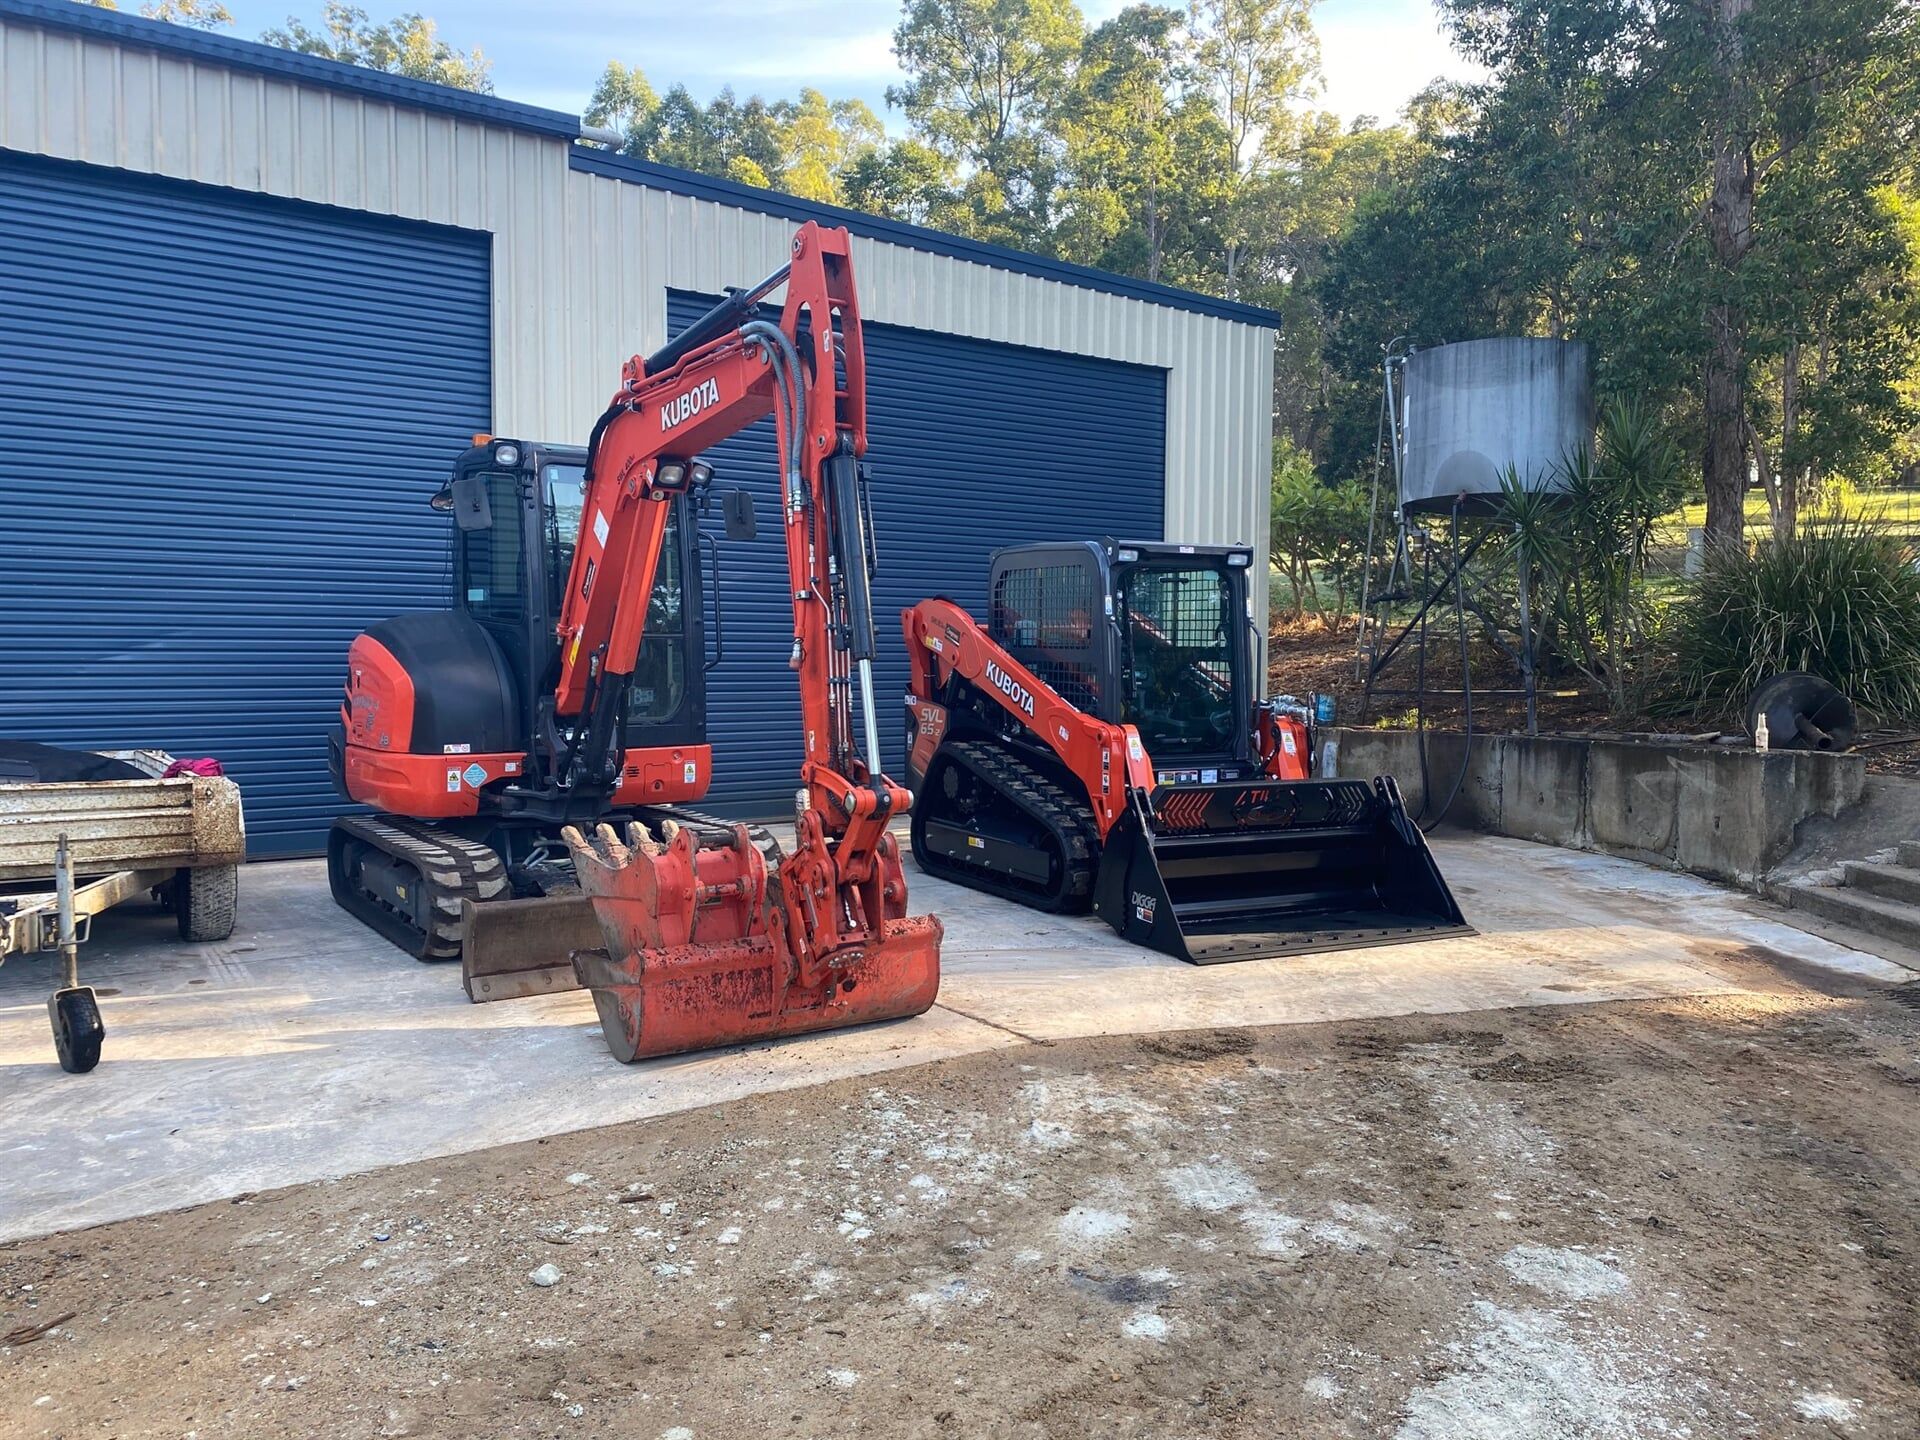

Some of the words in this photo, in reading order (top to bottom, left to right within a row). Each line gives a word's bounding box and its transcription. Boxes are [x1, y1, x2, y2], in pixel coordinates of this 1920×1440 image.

[661, 377, 719, 431] KUBOTA
[985, 659, 1035, 717] KUBOTA
[920, 708, 943, 722] SVL
[1131, 892, 1156, 911] DIGGA
